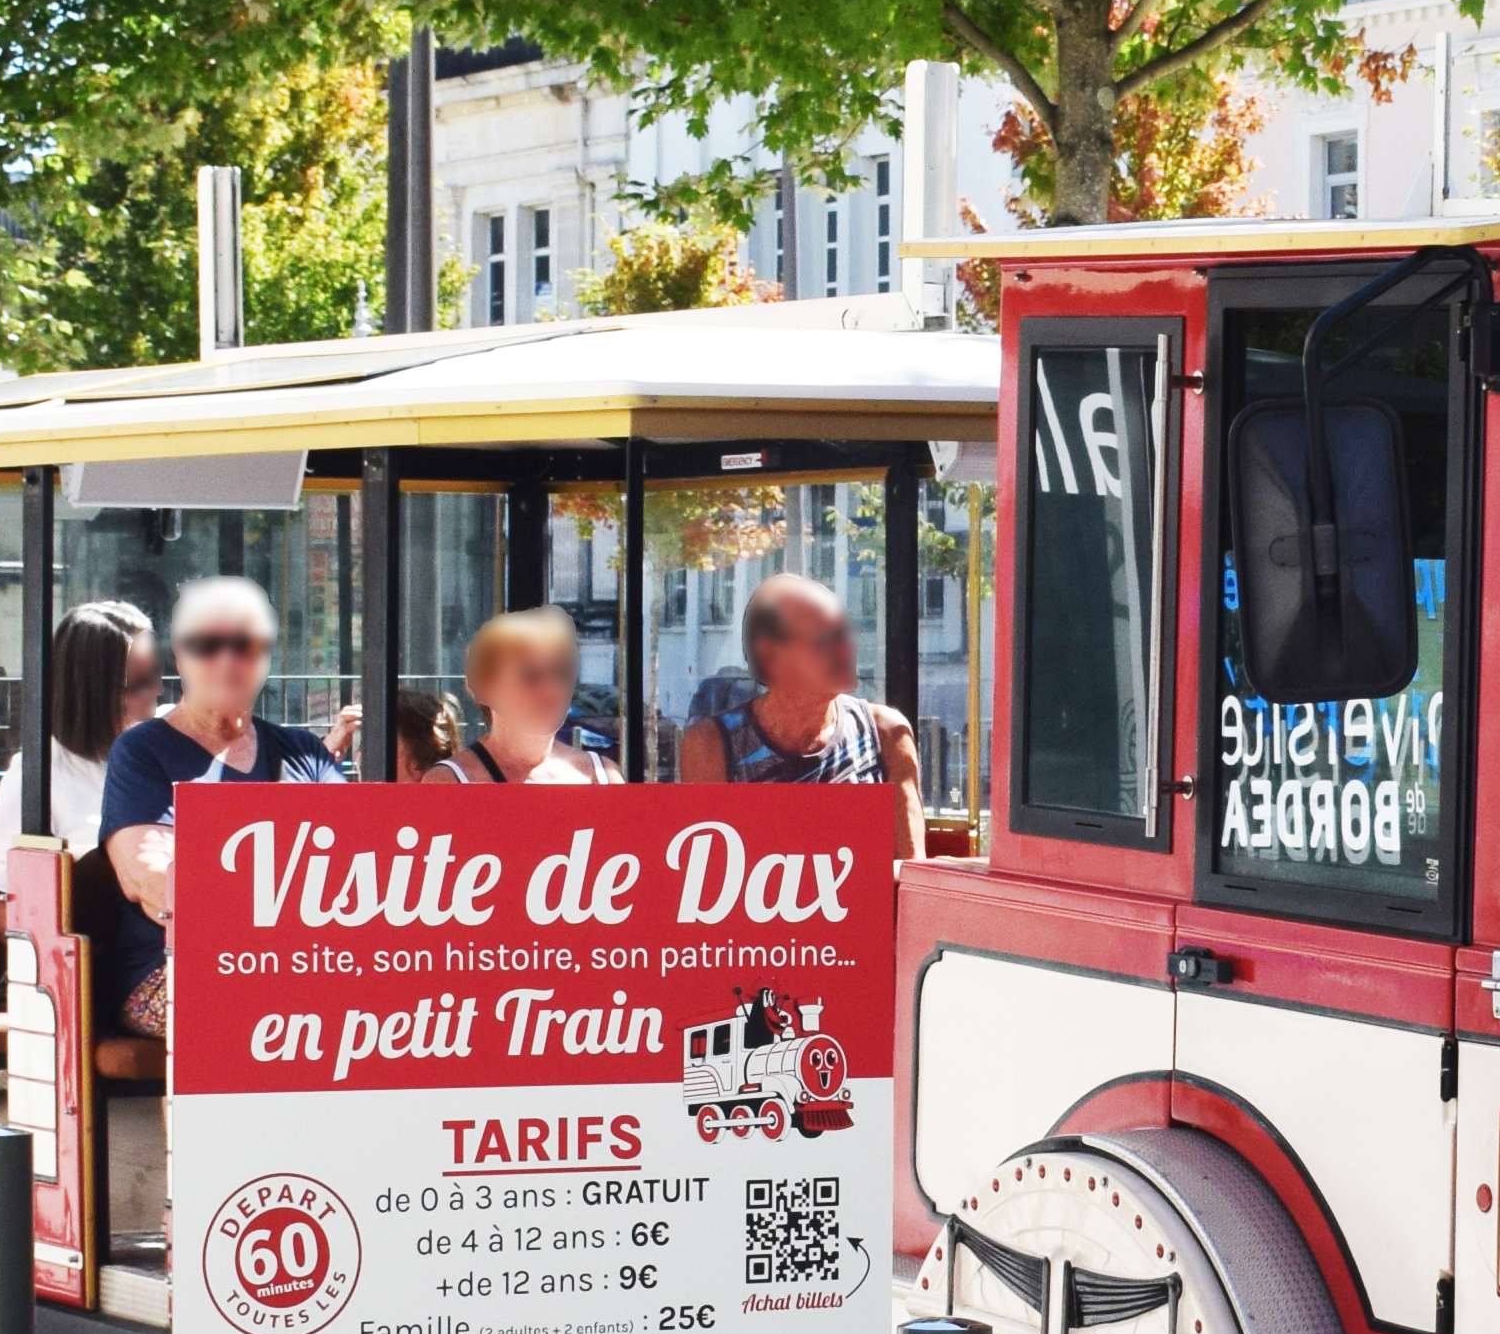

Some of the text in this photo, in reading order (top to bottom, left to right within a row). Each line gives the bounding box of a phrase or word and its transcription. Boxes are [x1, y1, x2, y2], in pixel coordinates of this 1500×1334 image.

[221, 821, 853, 927] Visite de Dax
[218, 939, 855, 977] son site, son histoire, son patrimoine...
[251, 989, 663, 1081] en petit Train
[442, 1115, 641, 1164] TARIFS
[219, 1184, 336, 1240] DEPART
[376, 1178, 709, 1213] de 0 à 3 ans GRATUIT
[239, 1223, 319, 1286] 60
[417, 1222, 669, 1255] de 4 à 12 ans 6€
[224, 1268, 347, 1330] TOUTES LES
[256, 1278, 315, 1298] minutes
[436, 1265, 657, 1297] +de 12 ans 9€
[577, 1320, 633, 1334] enfants)
[659, 1305, 715, 1330] 25€
[742, 1292, 842, 1314] Achat billets
